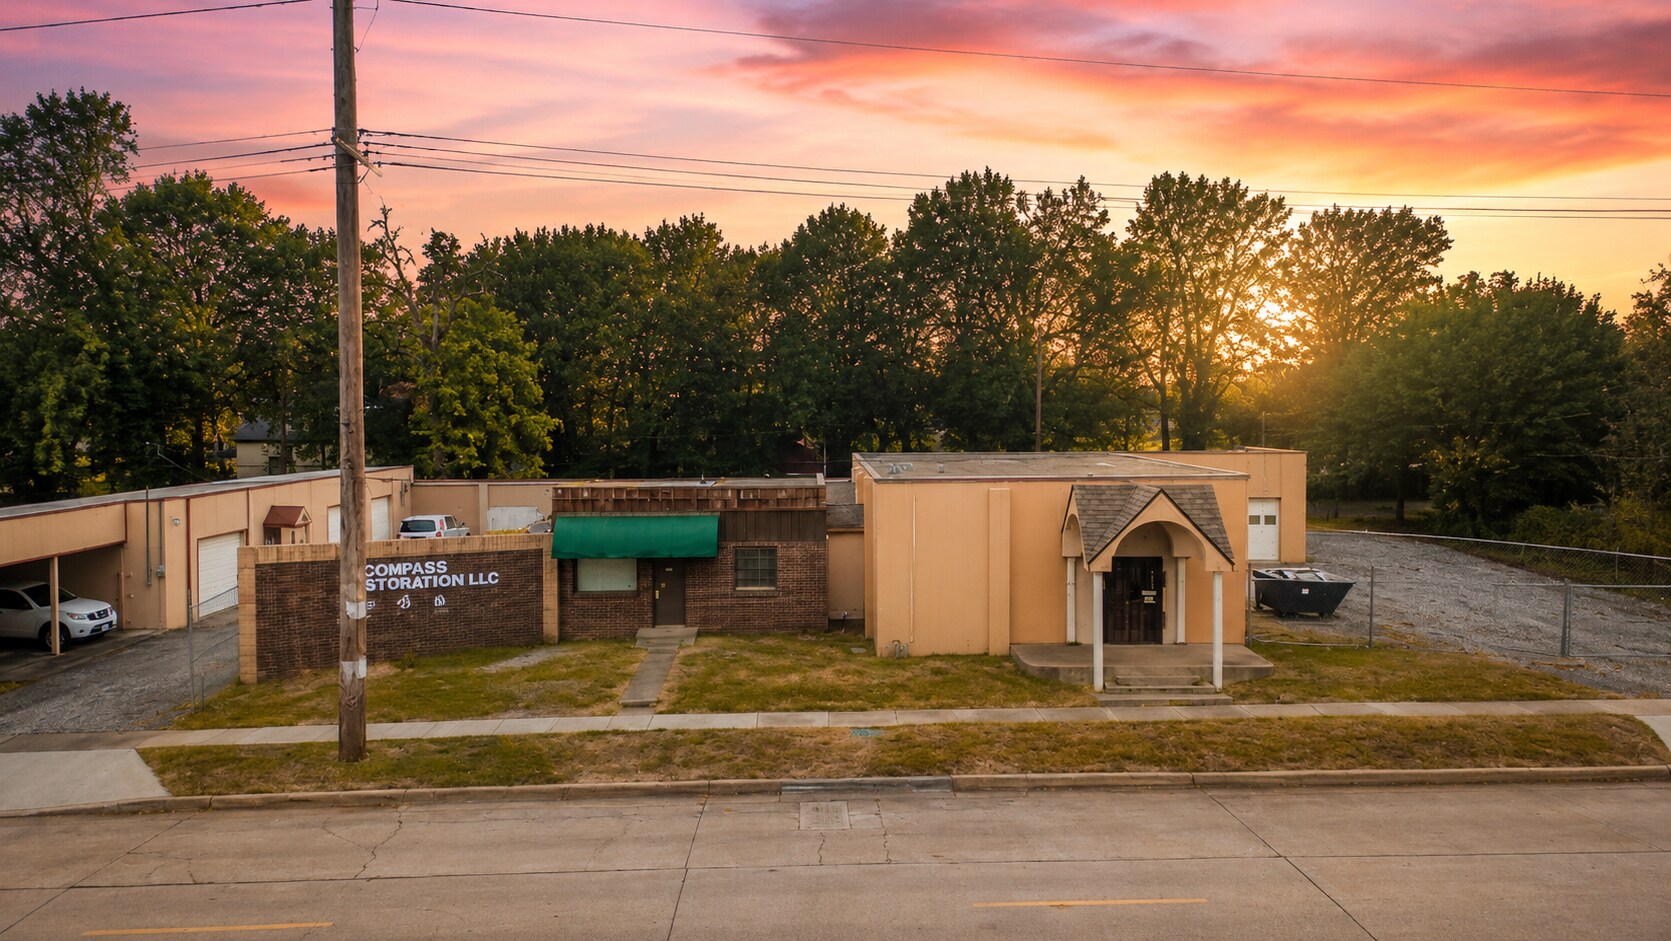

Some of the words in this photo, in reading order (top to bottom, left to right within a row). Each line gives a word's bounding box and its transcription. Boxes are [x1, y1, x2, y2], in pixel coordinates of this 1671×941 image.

[365, 561, 447, 577] COMPASS
[366, 574, 464, 591] STORATION
[469, 572, 499, 586] LLC
